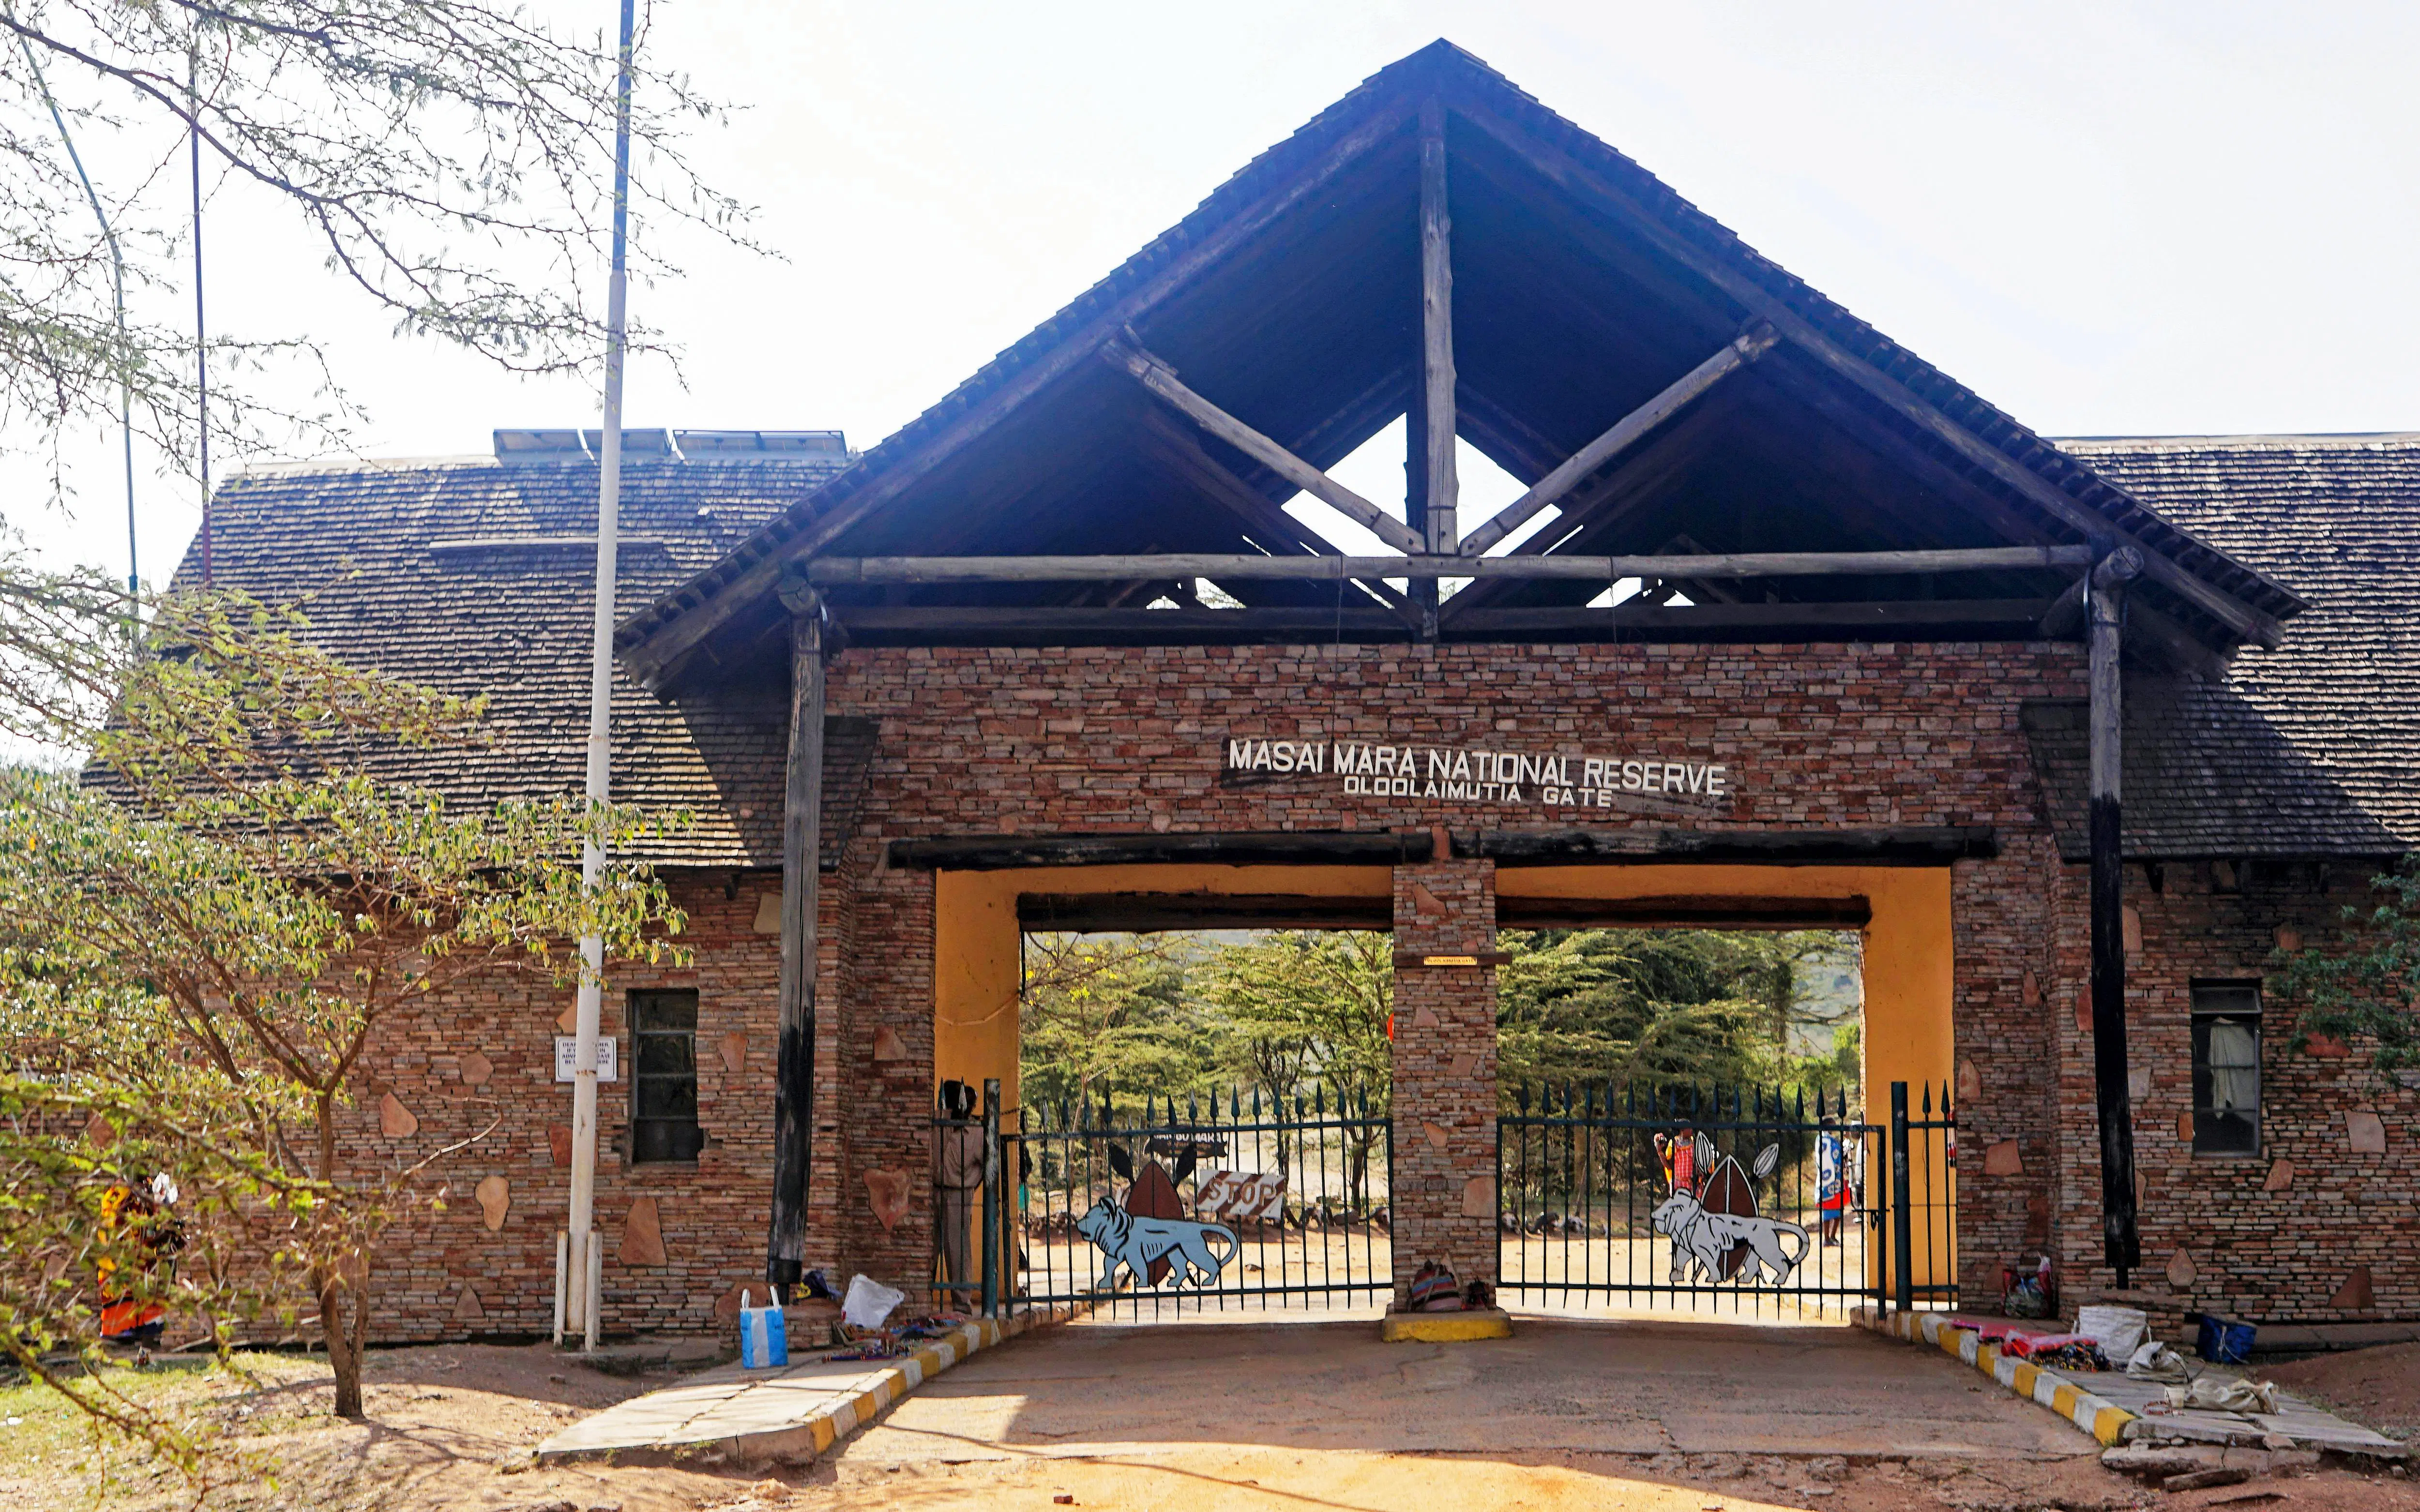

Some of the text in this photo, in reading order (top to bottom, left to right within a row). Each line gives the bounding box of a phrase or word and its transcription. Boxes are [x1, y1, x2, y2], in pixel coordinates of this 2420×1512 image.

[1229, 739, 1726, 796] MASAI MARA NATIONAL RESERVE
[1344, 776, 1613, 808] OLOOLAIMUTIA GATE
[1208, 1177, 1277, 1206] STOP
